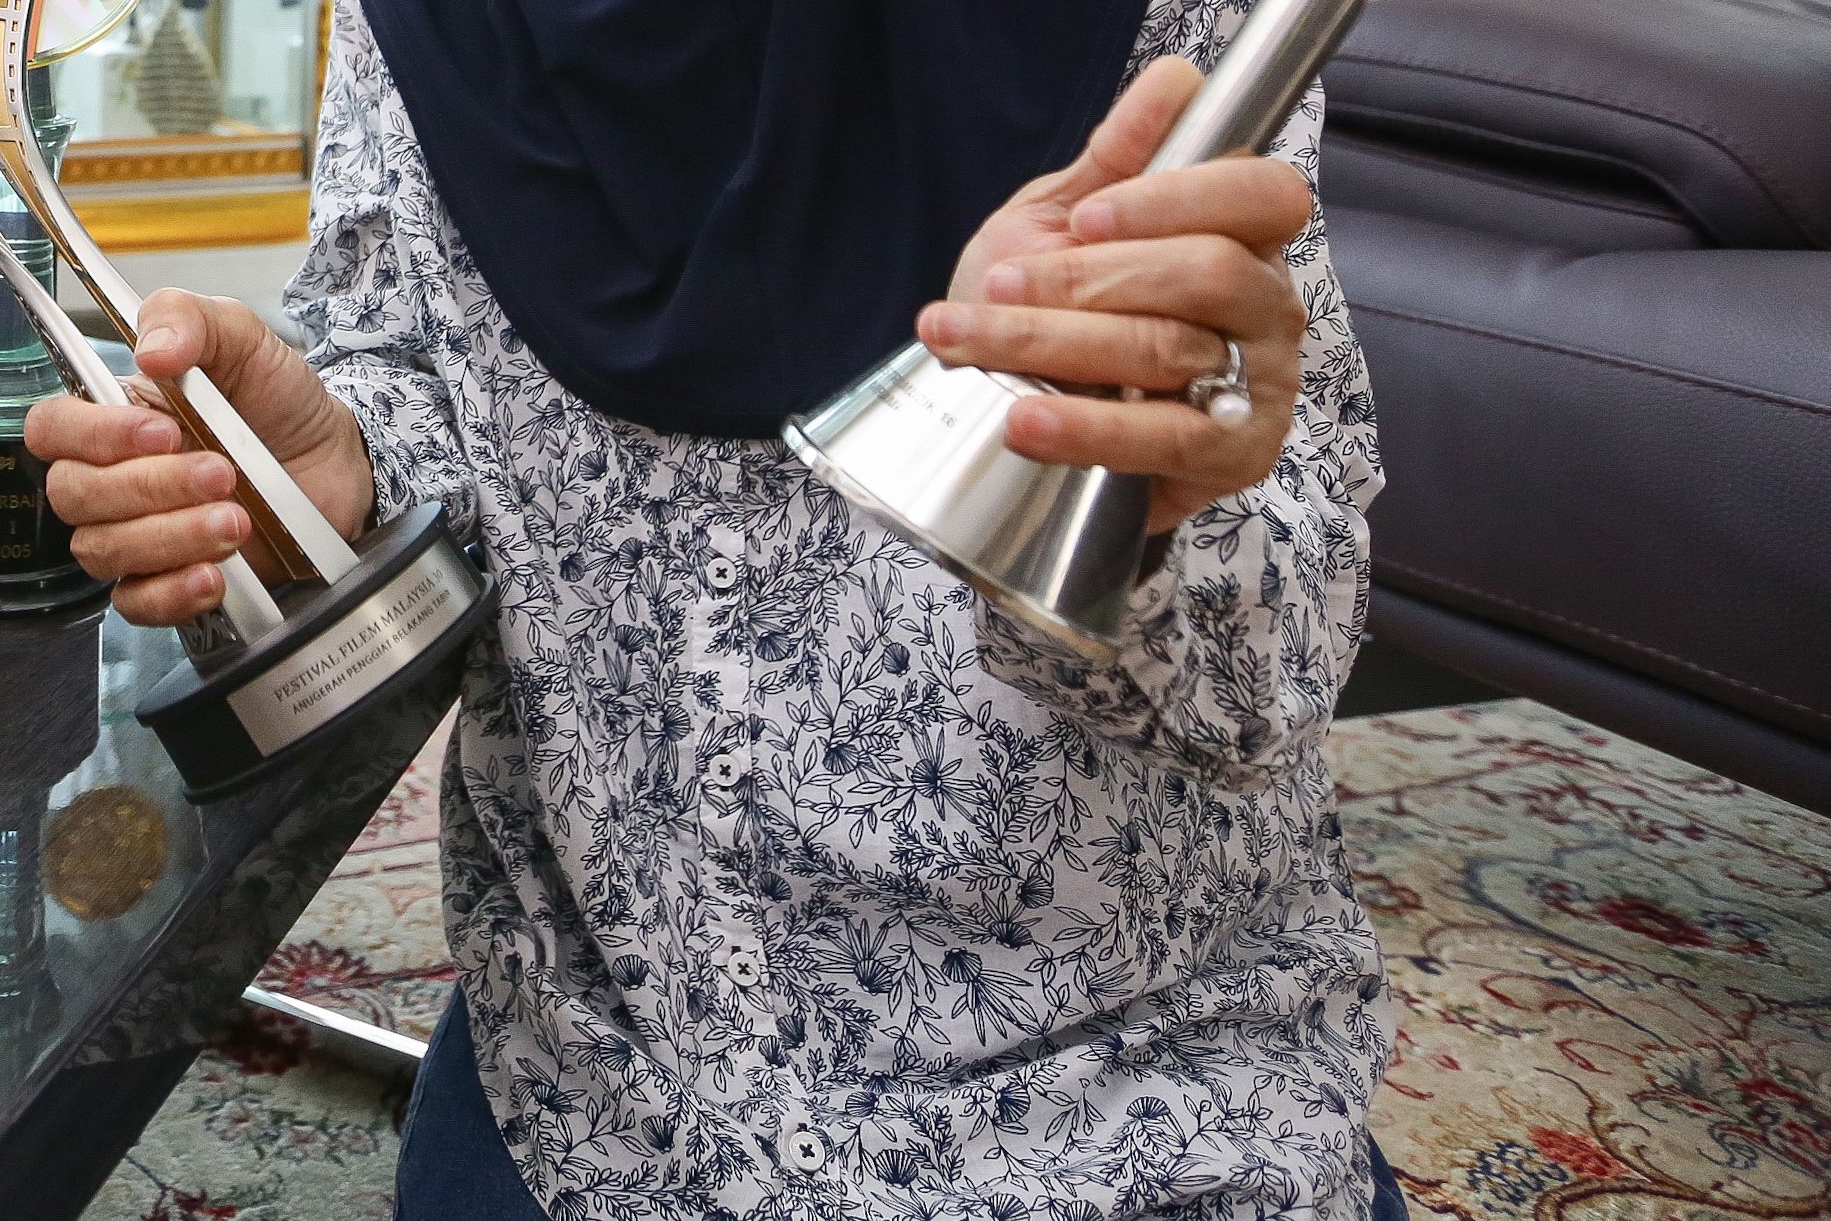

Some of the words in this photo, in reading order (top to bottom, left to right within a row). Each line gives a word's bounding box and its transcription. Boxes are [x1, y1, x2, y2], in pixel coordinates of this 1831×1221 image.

[292, 673, 349, 716] ANUGERAH
[346, 640, 394, 679] PENGGIAT
[392, 607, 435, 645] BELAKANG
[337, 621, 383, 660] FILEM
[379, 576, 436, 628] MALAYSIA
